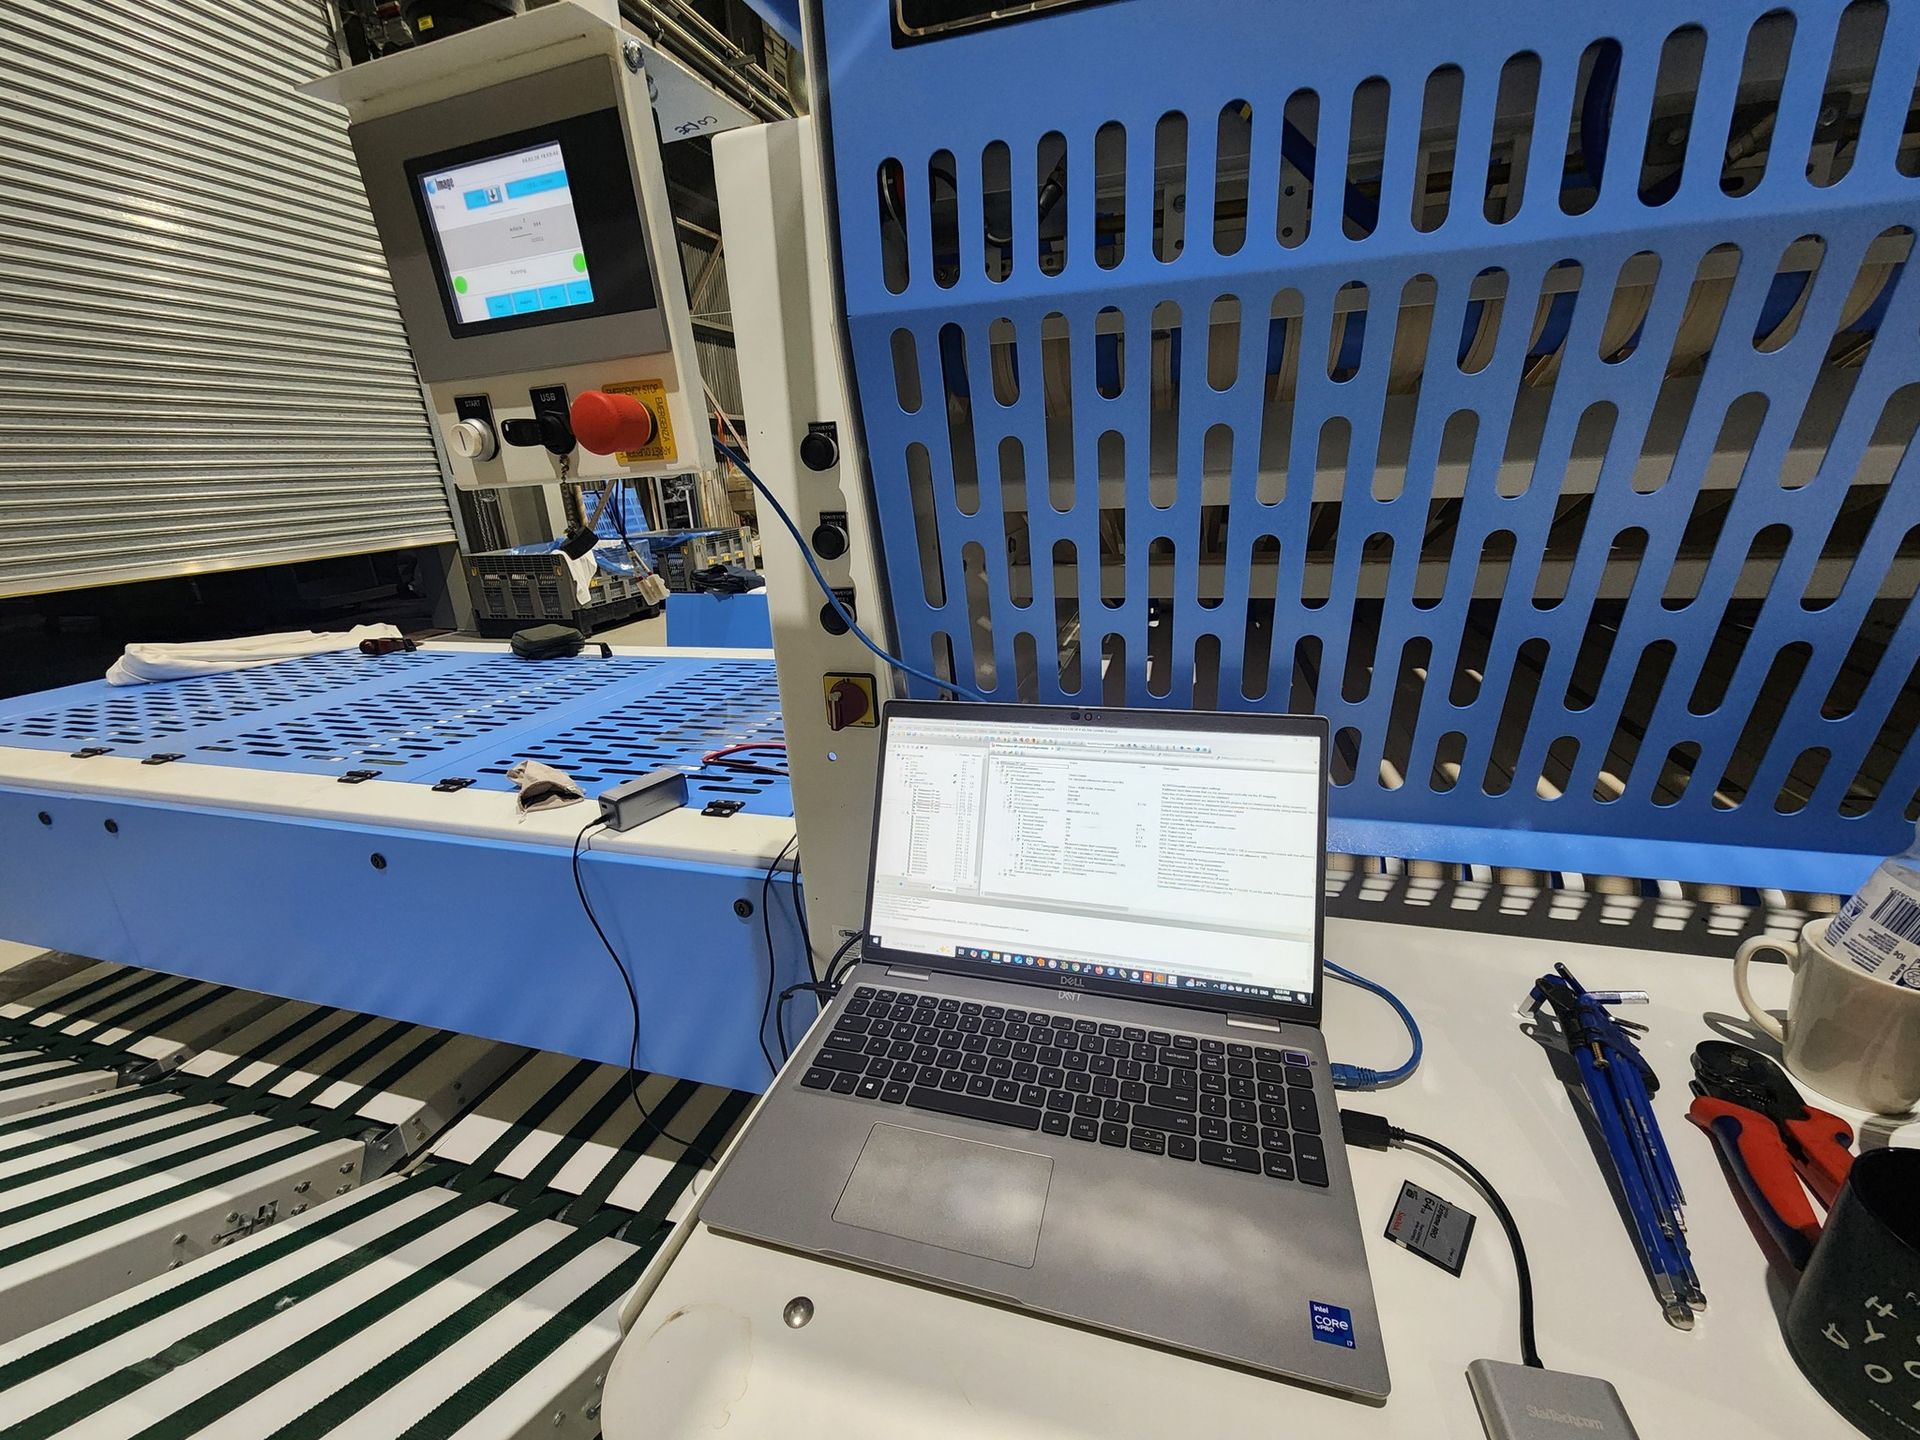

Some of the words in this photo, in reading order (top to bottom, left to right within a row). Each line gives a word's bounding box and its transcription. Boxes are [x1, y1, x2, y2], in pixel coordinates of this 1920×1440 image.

[540, 392, 556, 402] USB
[464, 400, 480, 408] START
[1060, 976, 1085, 988] DELL
[1425, 1198, 1436, 1212] 64
